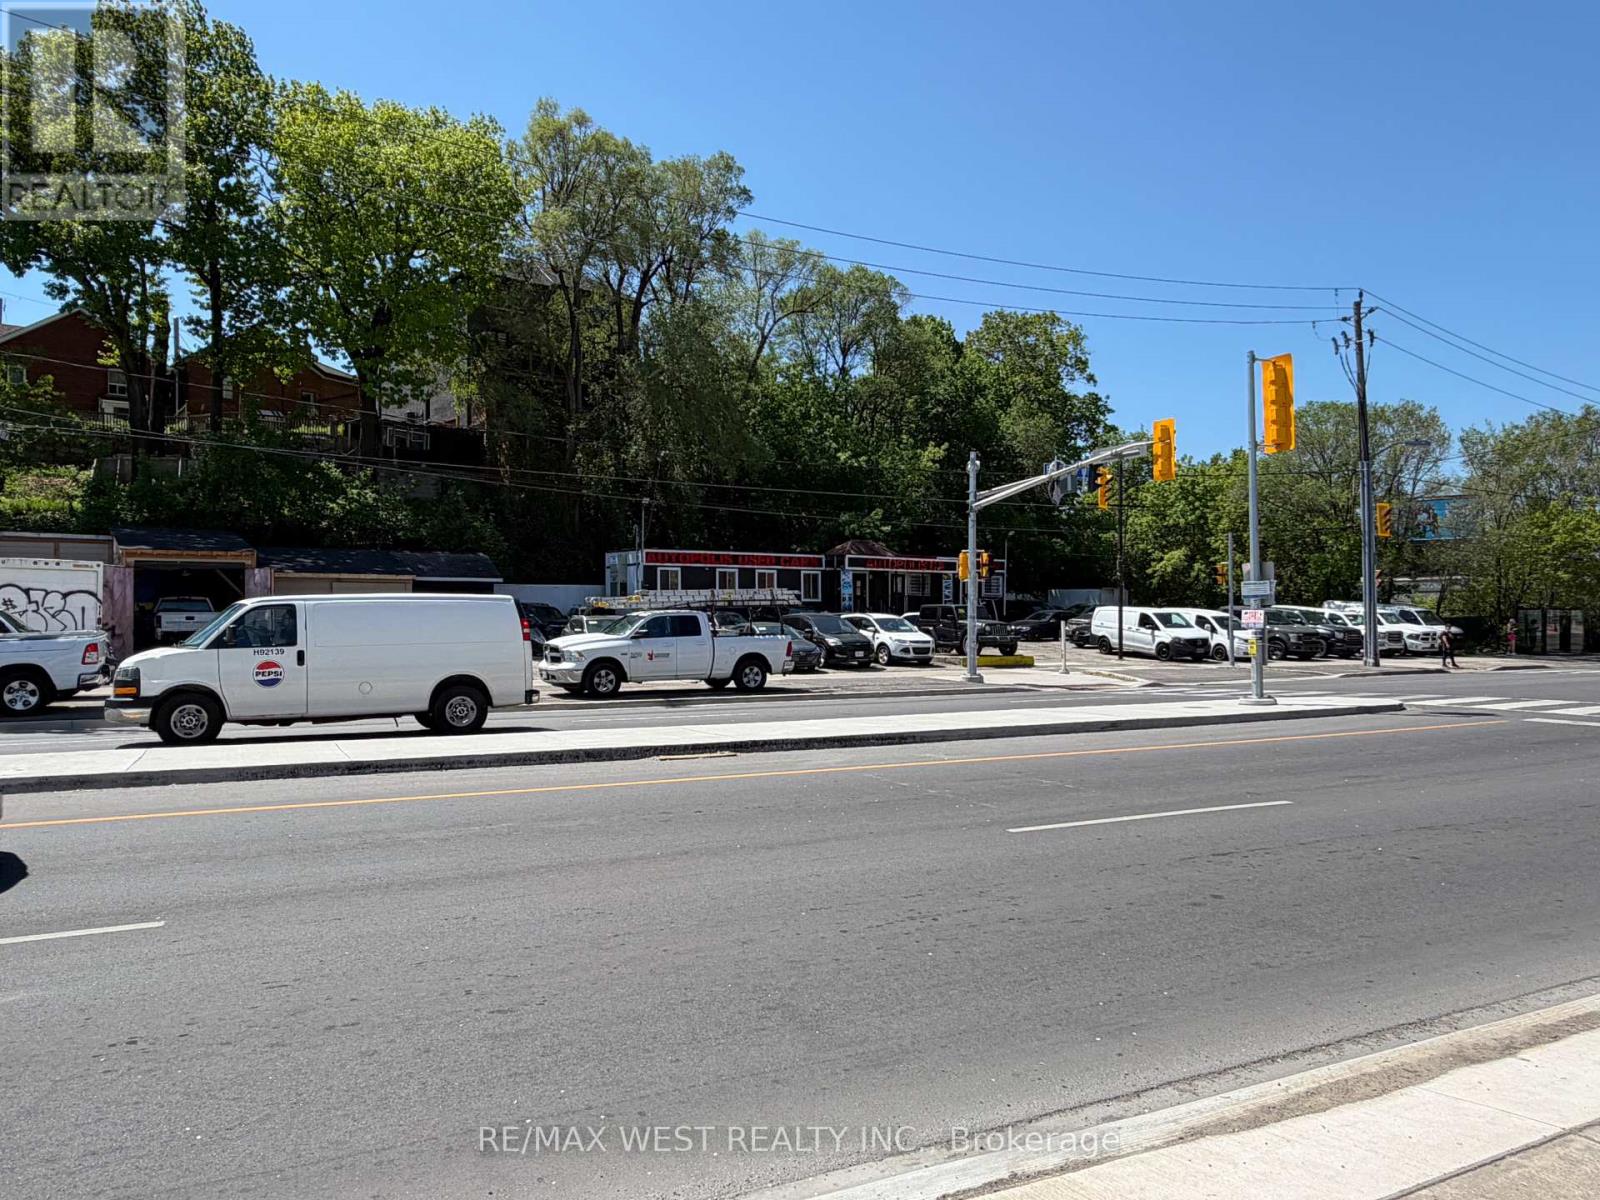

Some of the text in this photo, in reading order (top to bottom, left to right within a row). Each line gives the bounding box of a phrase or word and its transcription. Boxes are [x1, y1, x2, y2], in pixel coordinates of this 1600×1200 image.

[646, 552, 734, 565] AUTOPOLIS
[738, 555, 776, 567] USED
[253, 648, 285, 656] H92139
